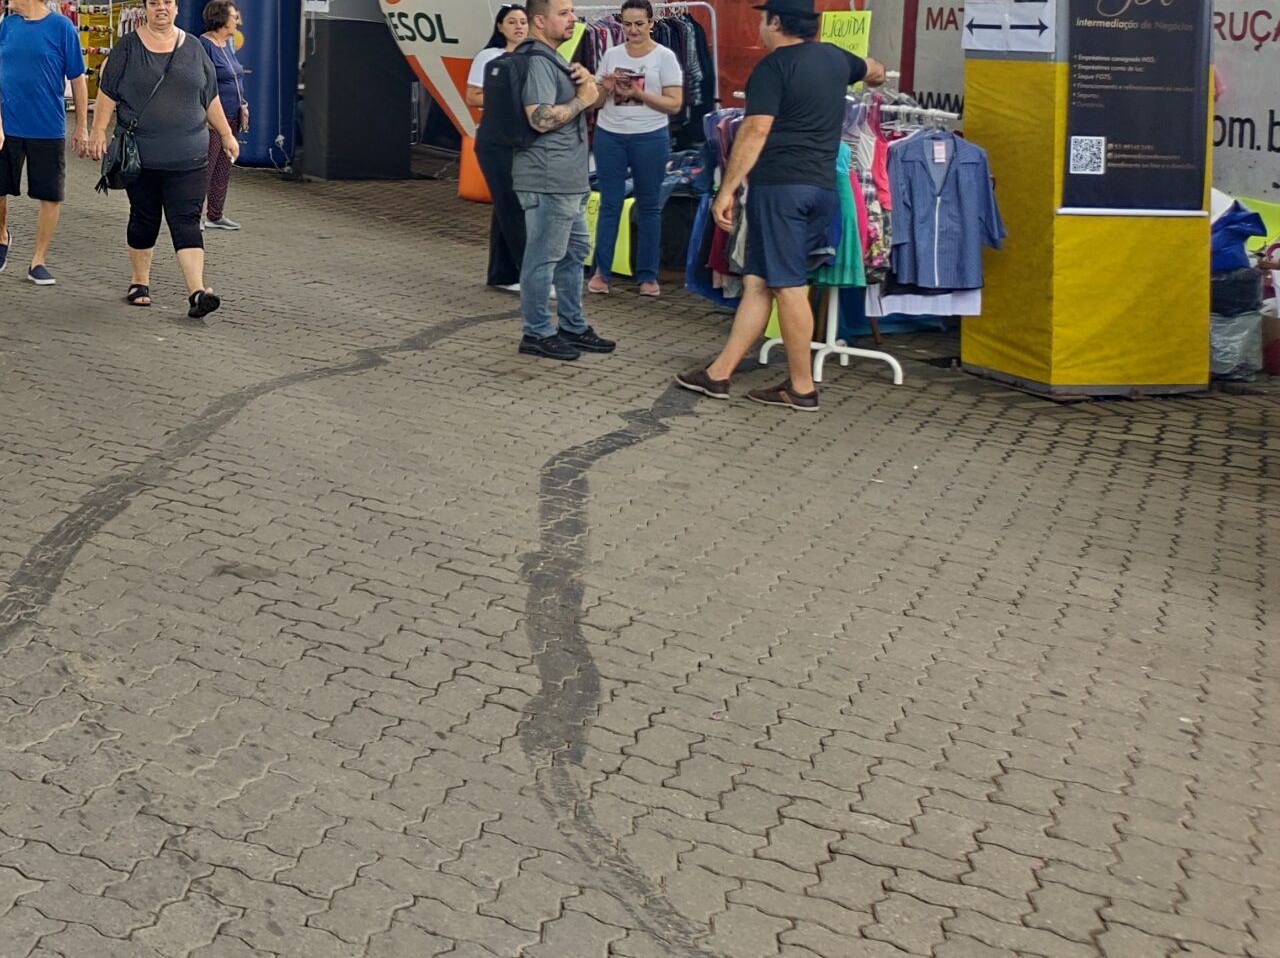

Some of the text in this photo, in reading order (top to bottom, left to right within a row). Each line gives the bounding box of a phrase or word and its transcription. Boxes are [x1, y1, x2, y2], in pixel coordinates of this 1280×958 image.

[385, 11, 460, 44] ESOL
[1076, 18, 1139, 31] Intermediação
[1140, 20, 1152, 29] de
